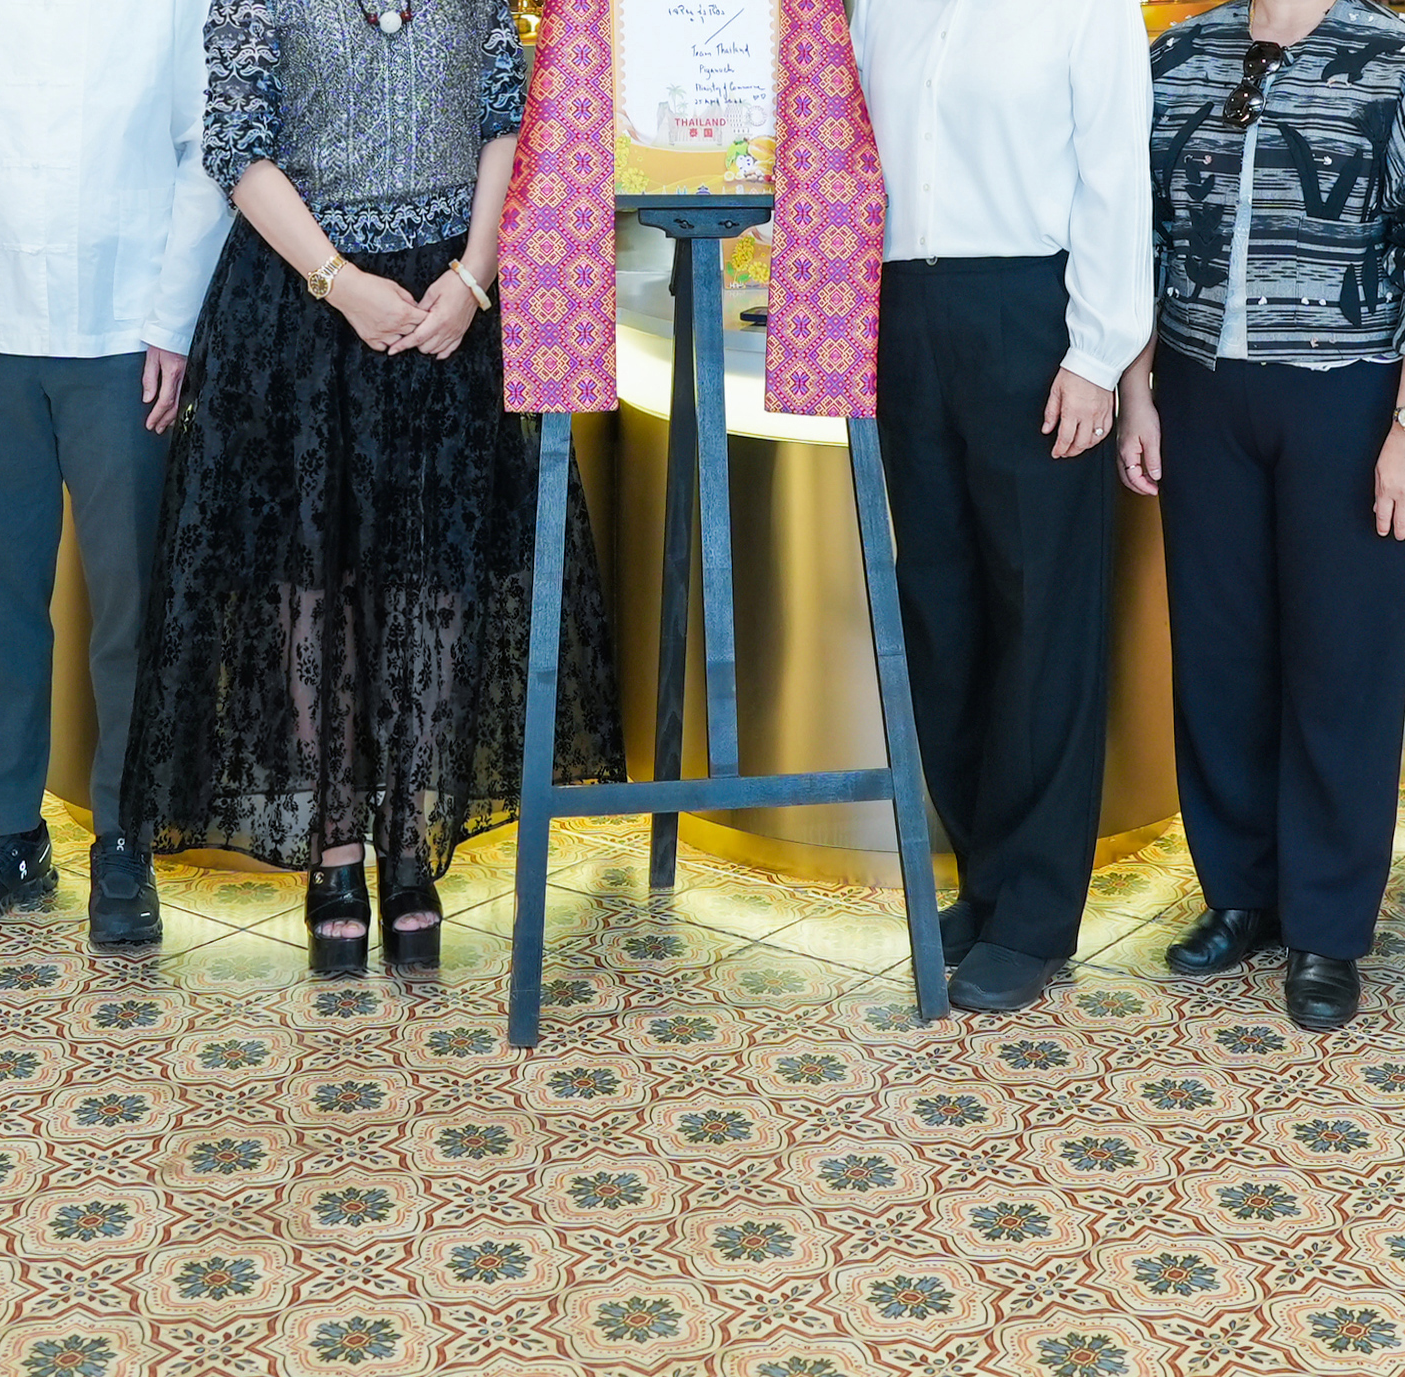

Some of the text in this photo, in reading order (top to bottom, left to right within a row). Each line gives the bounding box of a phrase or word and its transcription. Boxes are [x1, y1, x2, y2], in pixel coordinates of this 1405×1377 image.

[691, 41, 751, 57] Team Thailand
[675, 117, 727, 127] THAILAND
